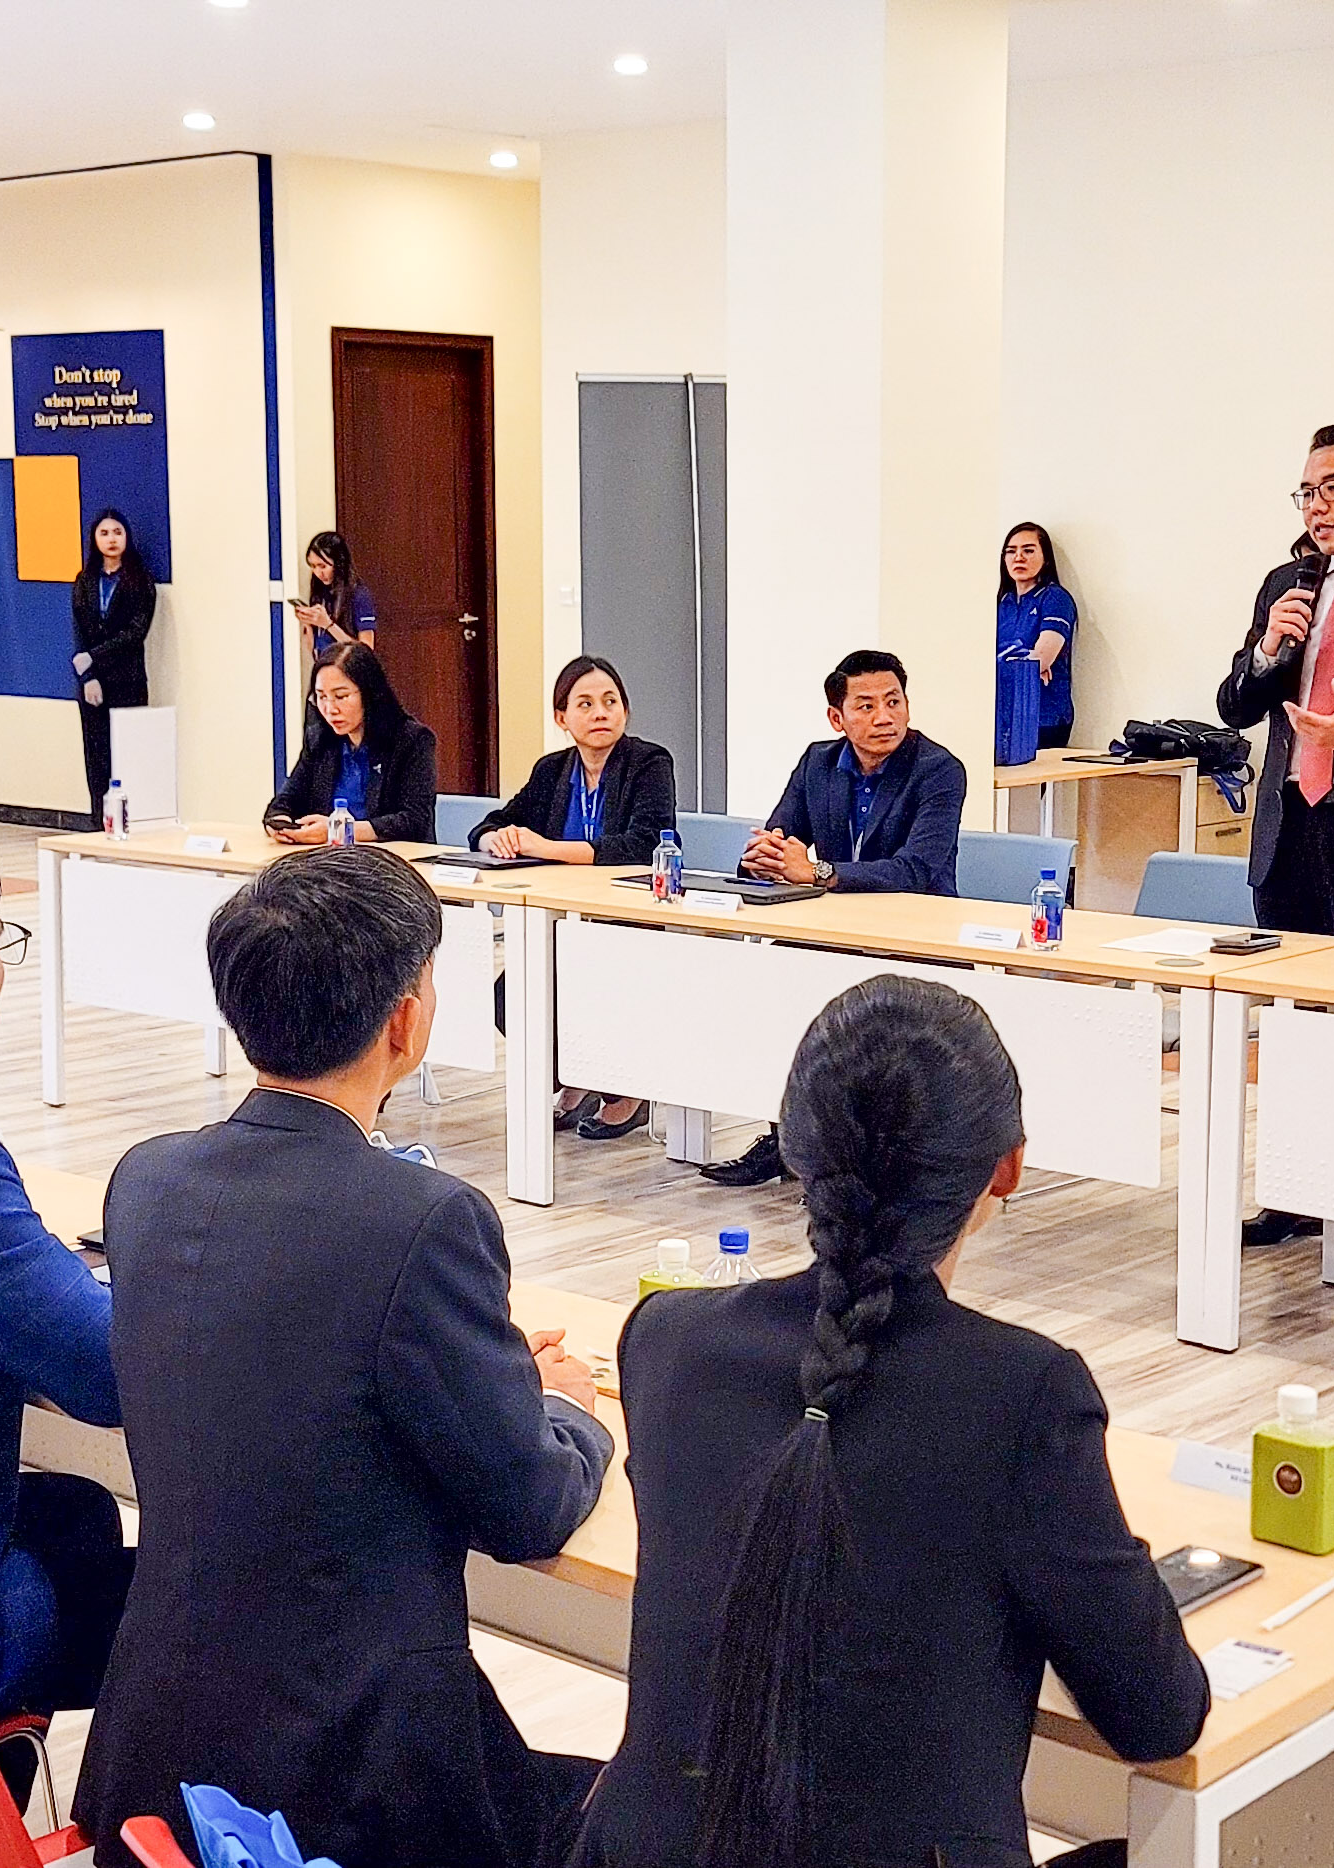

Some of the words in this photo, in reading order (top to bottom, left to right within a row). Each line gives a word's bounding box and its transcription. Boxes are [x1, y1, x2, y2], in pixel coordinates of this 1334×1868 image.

[53, 364, 91, 385] Don't
[92, 367, 121, 388] stop
[43, 391, 74, 408] when
[74, 390, 108, 411] you're
[110, 387, 138, 407] tired
[34, 412, 59, 431] Stop
[60, 409, 89, 426] when
[90, 409, 124, 430] you're
[125, 408, 153, 425] done
